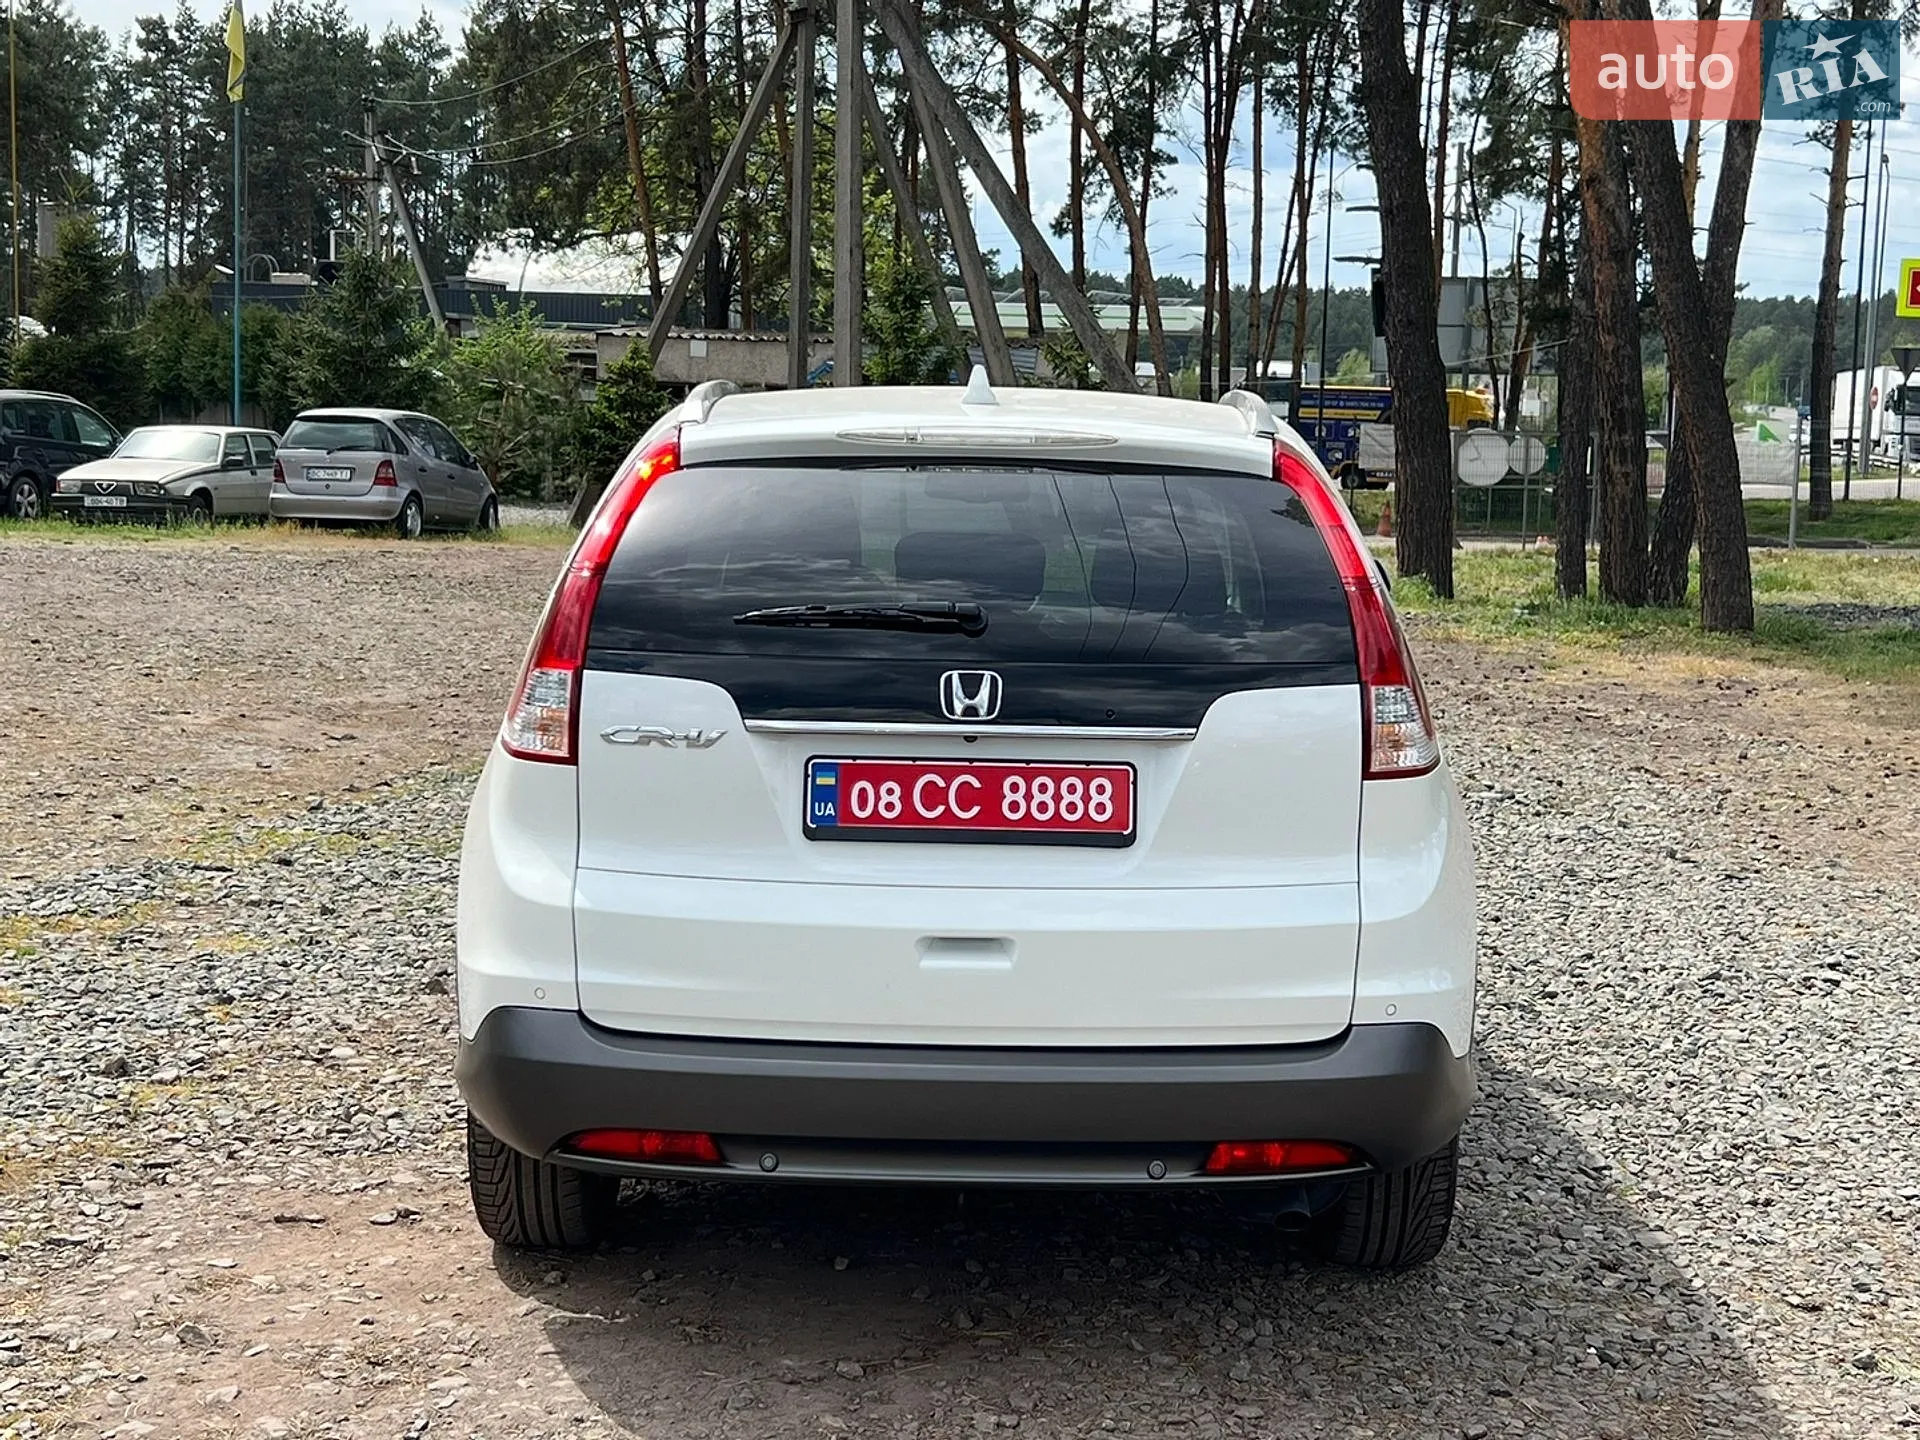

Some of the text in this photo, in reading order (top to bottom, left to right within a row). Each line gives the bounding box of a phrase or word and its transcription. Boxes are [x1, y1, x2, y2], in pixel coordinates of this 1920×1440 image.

[600, 725, 728, 749] CR-V
[814, 801, 836, 816] UA
[850, 773, 1113, 822] 08 CC 8888
